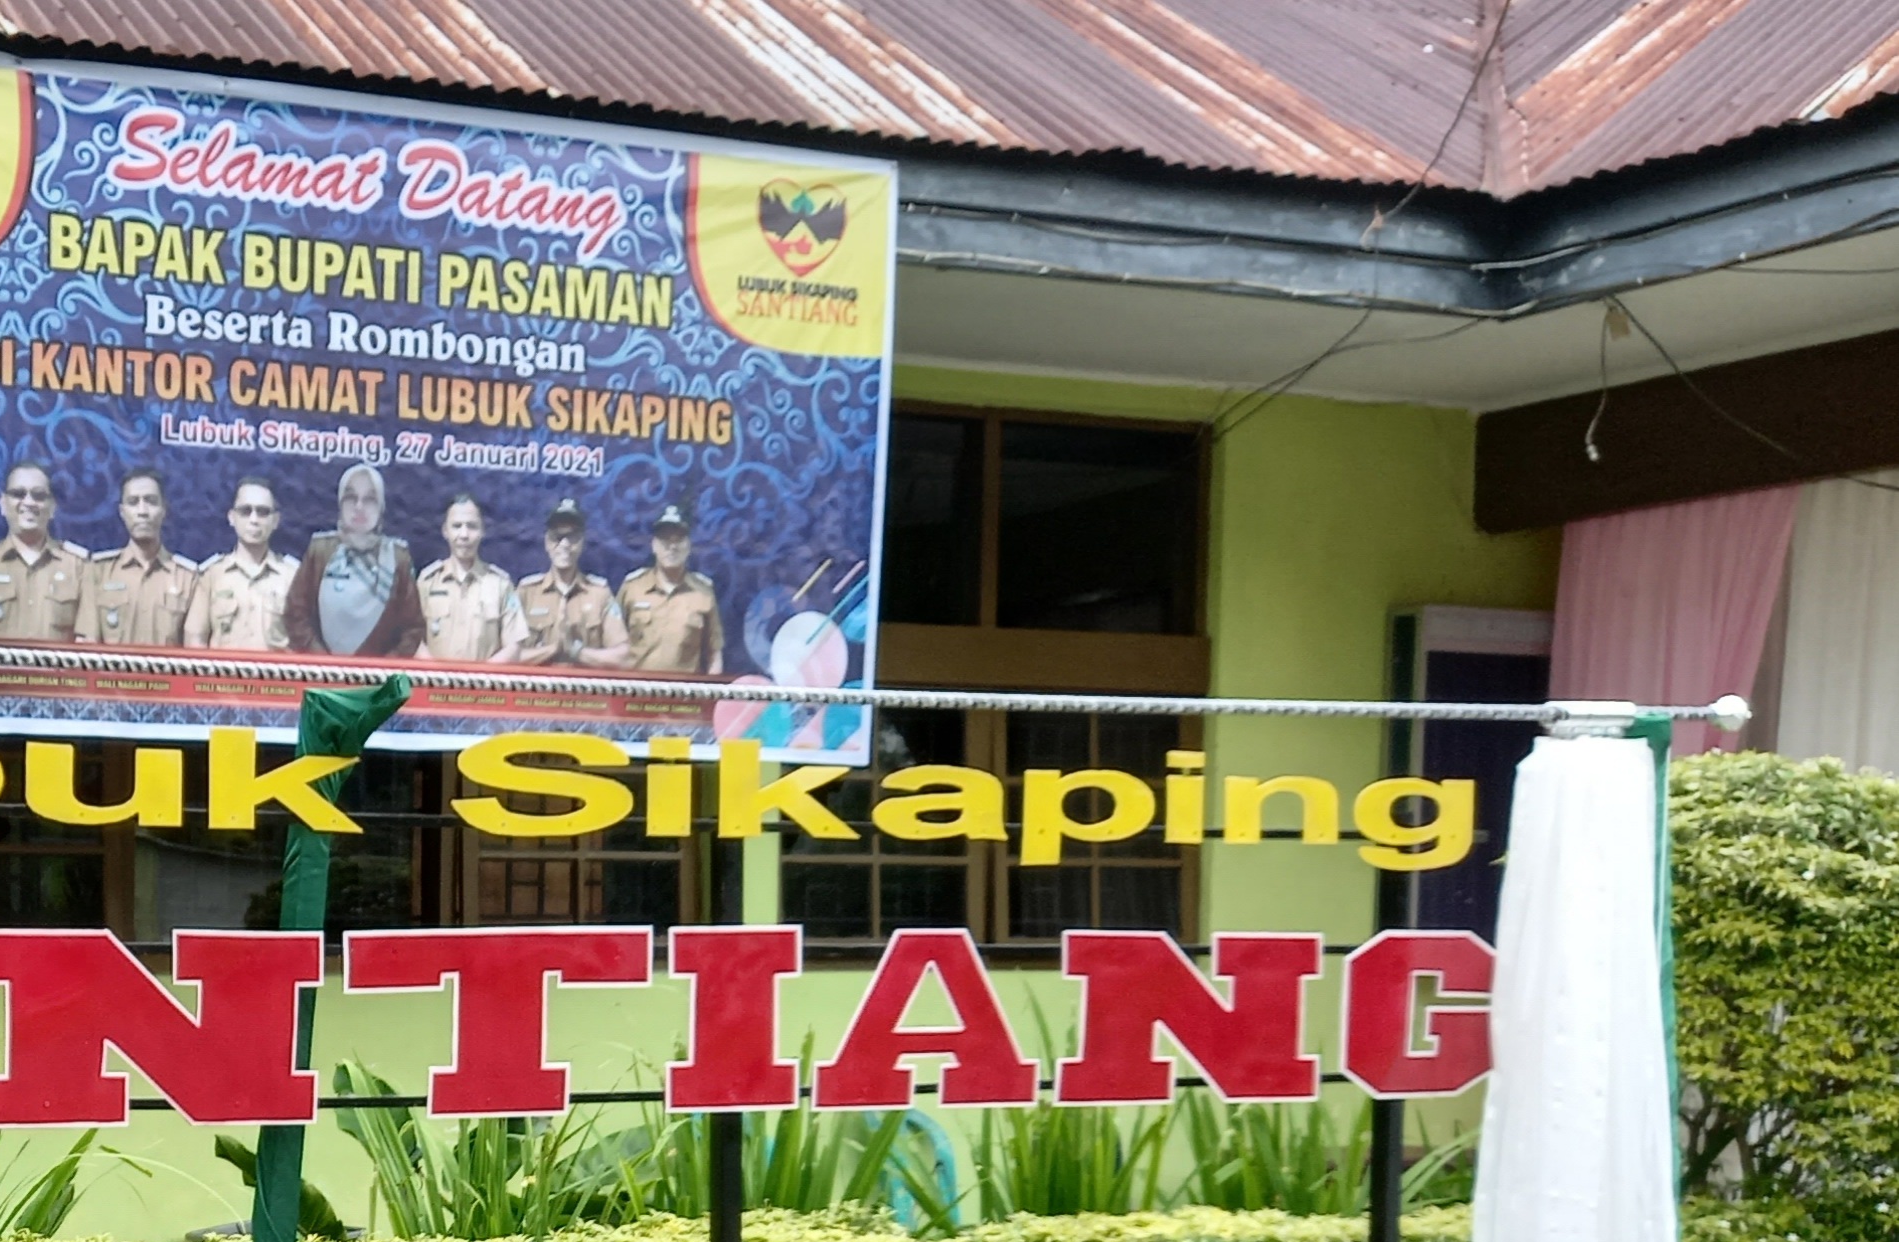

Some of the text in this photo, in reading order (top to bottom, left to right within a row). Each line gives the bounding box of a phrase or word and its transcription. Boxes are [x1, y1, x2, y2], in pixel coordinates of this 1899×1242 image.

[110, 108, 624, 260] Selamat Datang
[49, 212, 674, 328] BAPAK BUPATI PASAMAN
[736, 288, 859, 327] SANTIANG
[737, 275, 859, 302] LUBUK SIKAPING
[144, 294, 587, 377] Beserta Rombongan
[32, 341, 214, 402] KANTOR
[229, 358, 385, 416] CAMAT
[398, 373, 534, 429] LUBUK
[547, 385, 734, 445] SIKAPING
[161, 413, 604, 477] Lubuk Sikaping, 27 Januari 2021
[451, 731, 1477, 871] Sikaping
